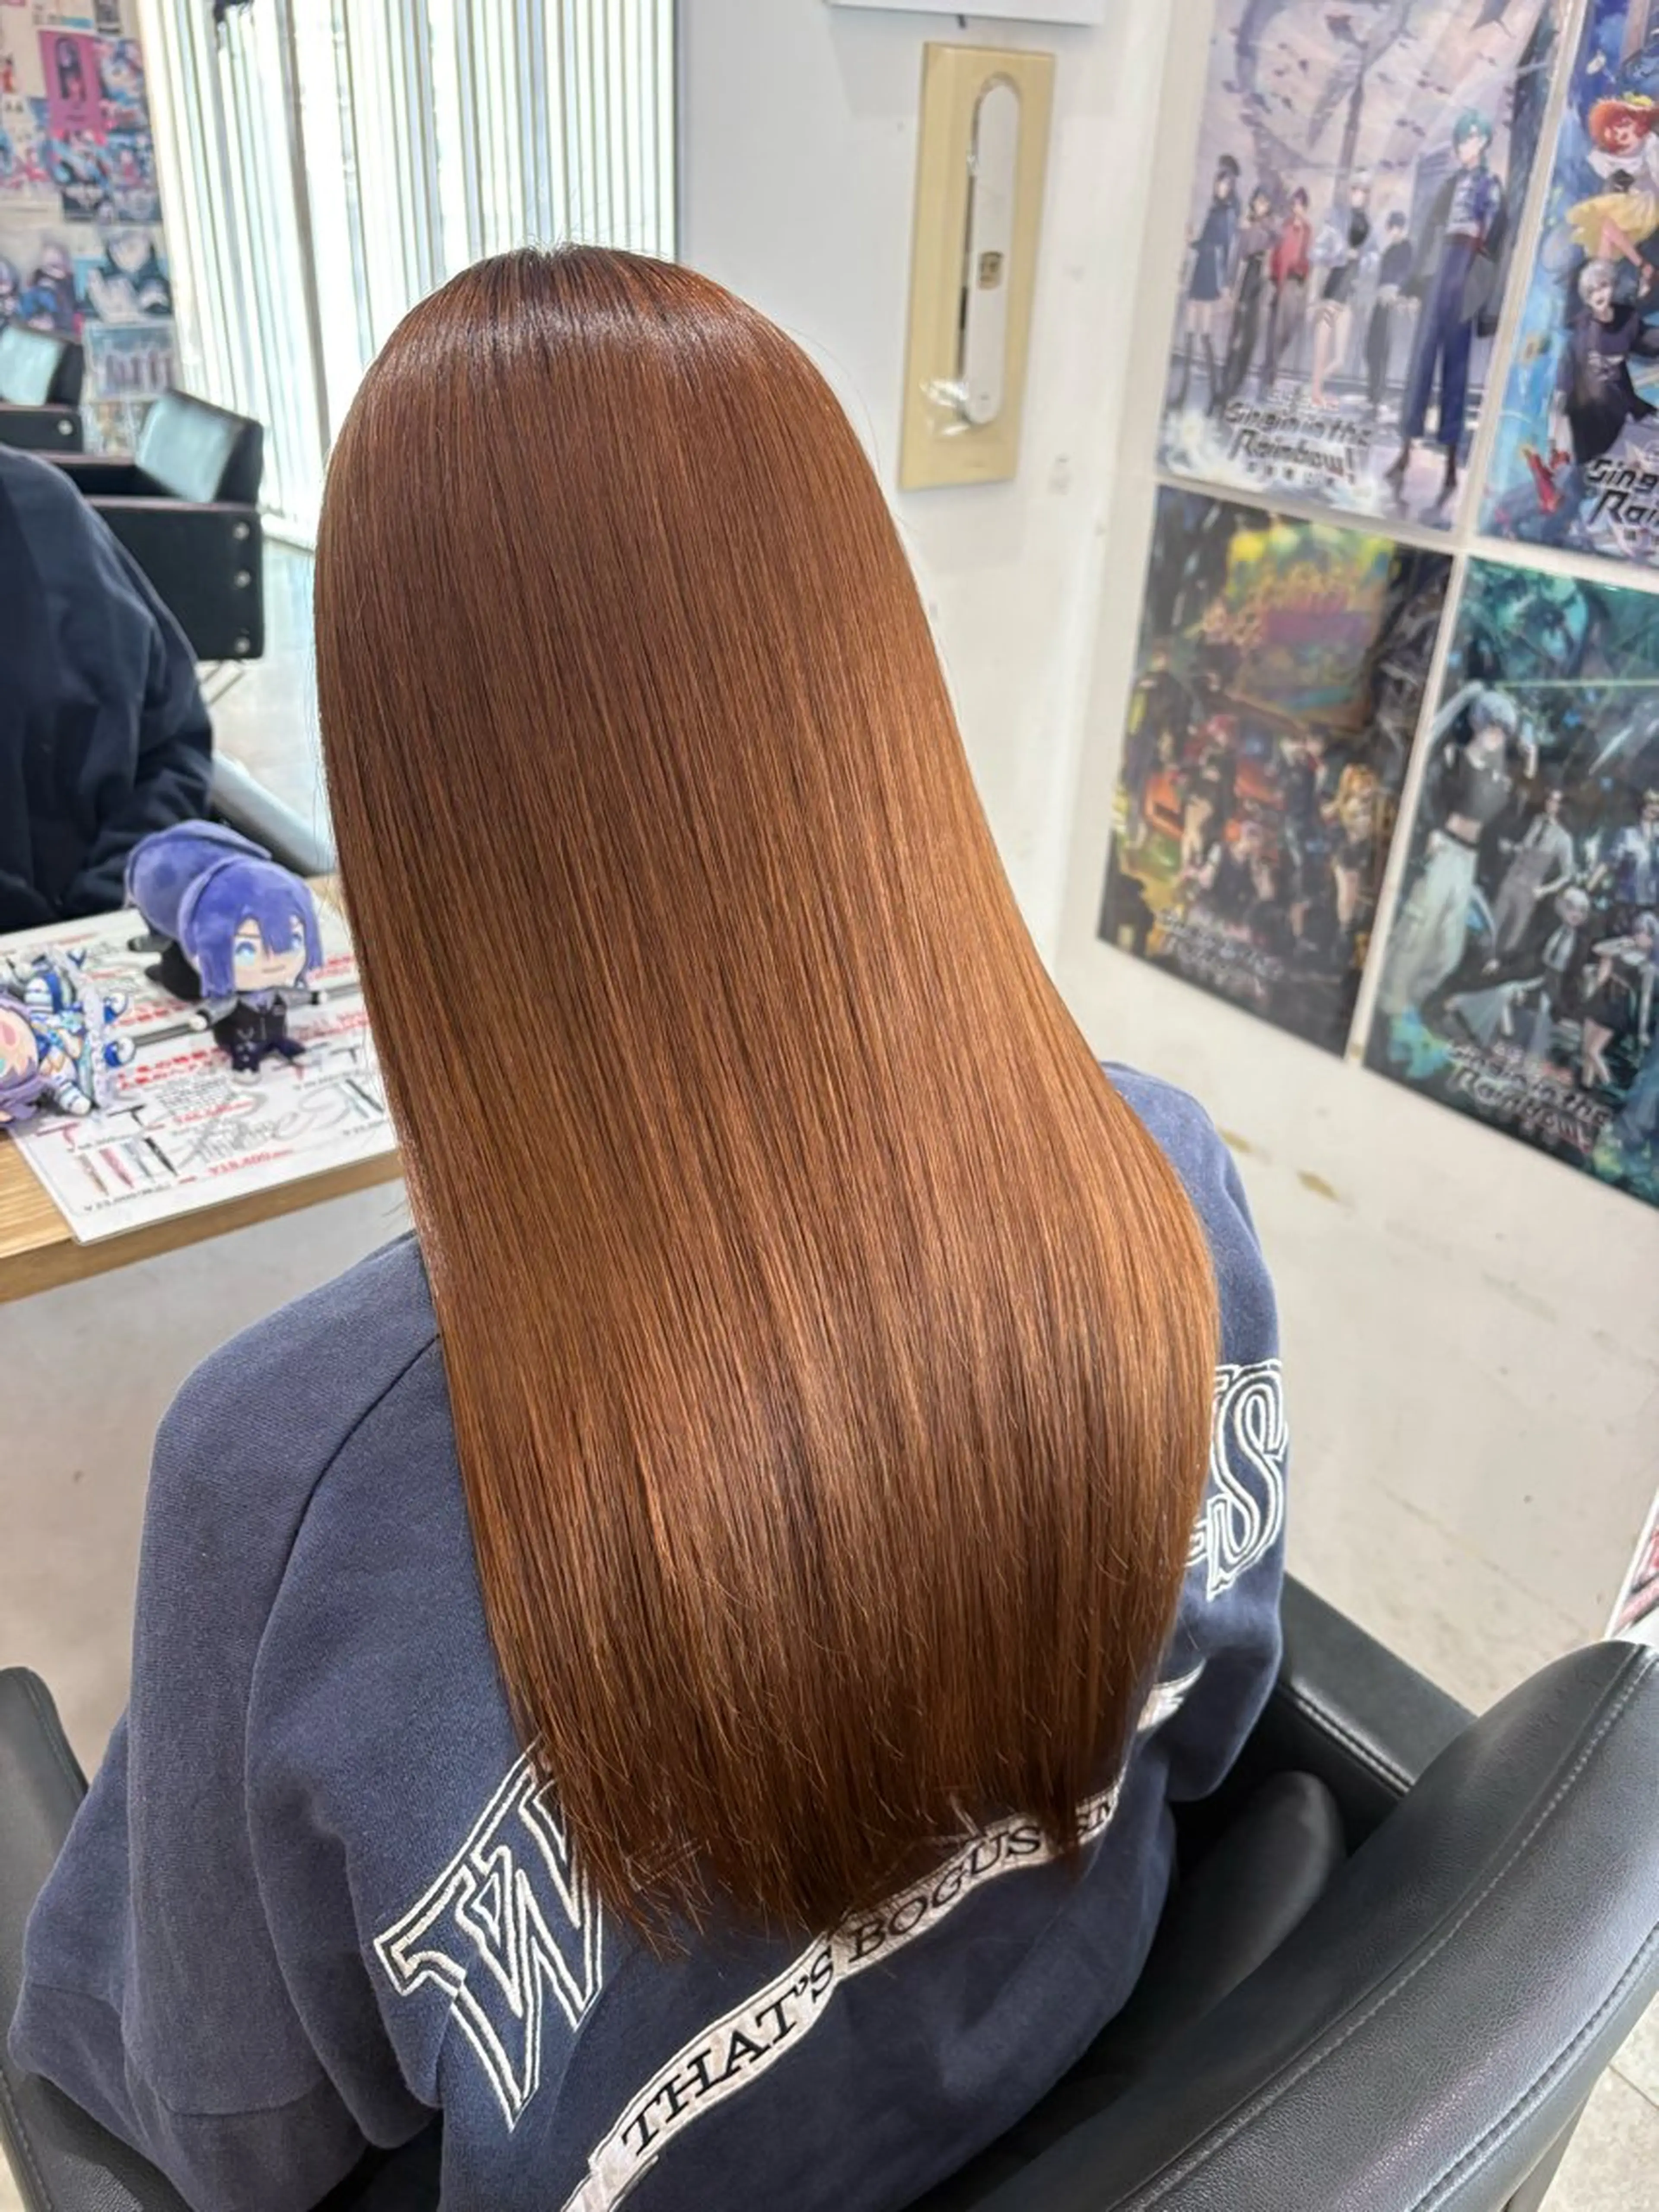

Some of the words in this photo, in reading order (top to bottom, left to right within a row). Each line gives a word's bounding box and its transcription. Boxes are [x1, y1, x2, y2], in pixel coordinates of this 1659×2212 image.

[1587, 489, 1659, 528] Rai
[621, 1945, 835, 2155] THAT'S
[849, 1826, 1040, 1962] BOGUS
